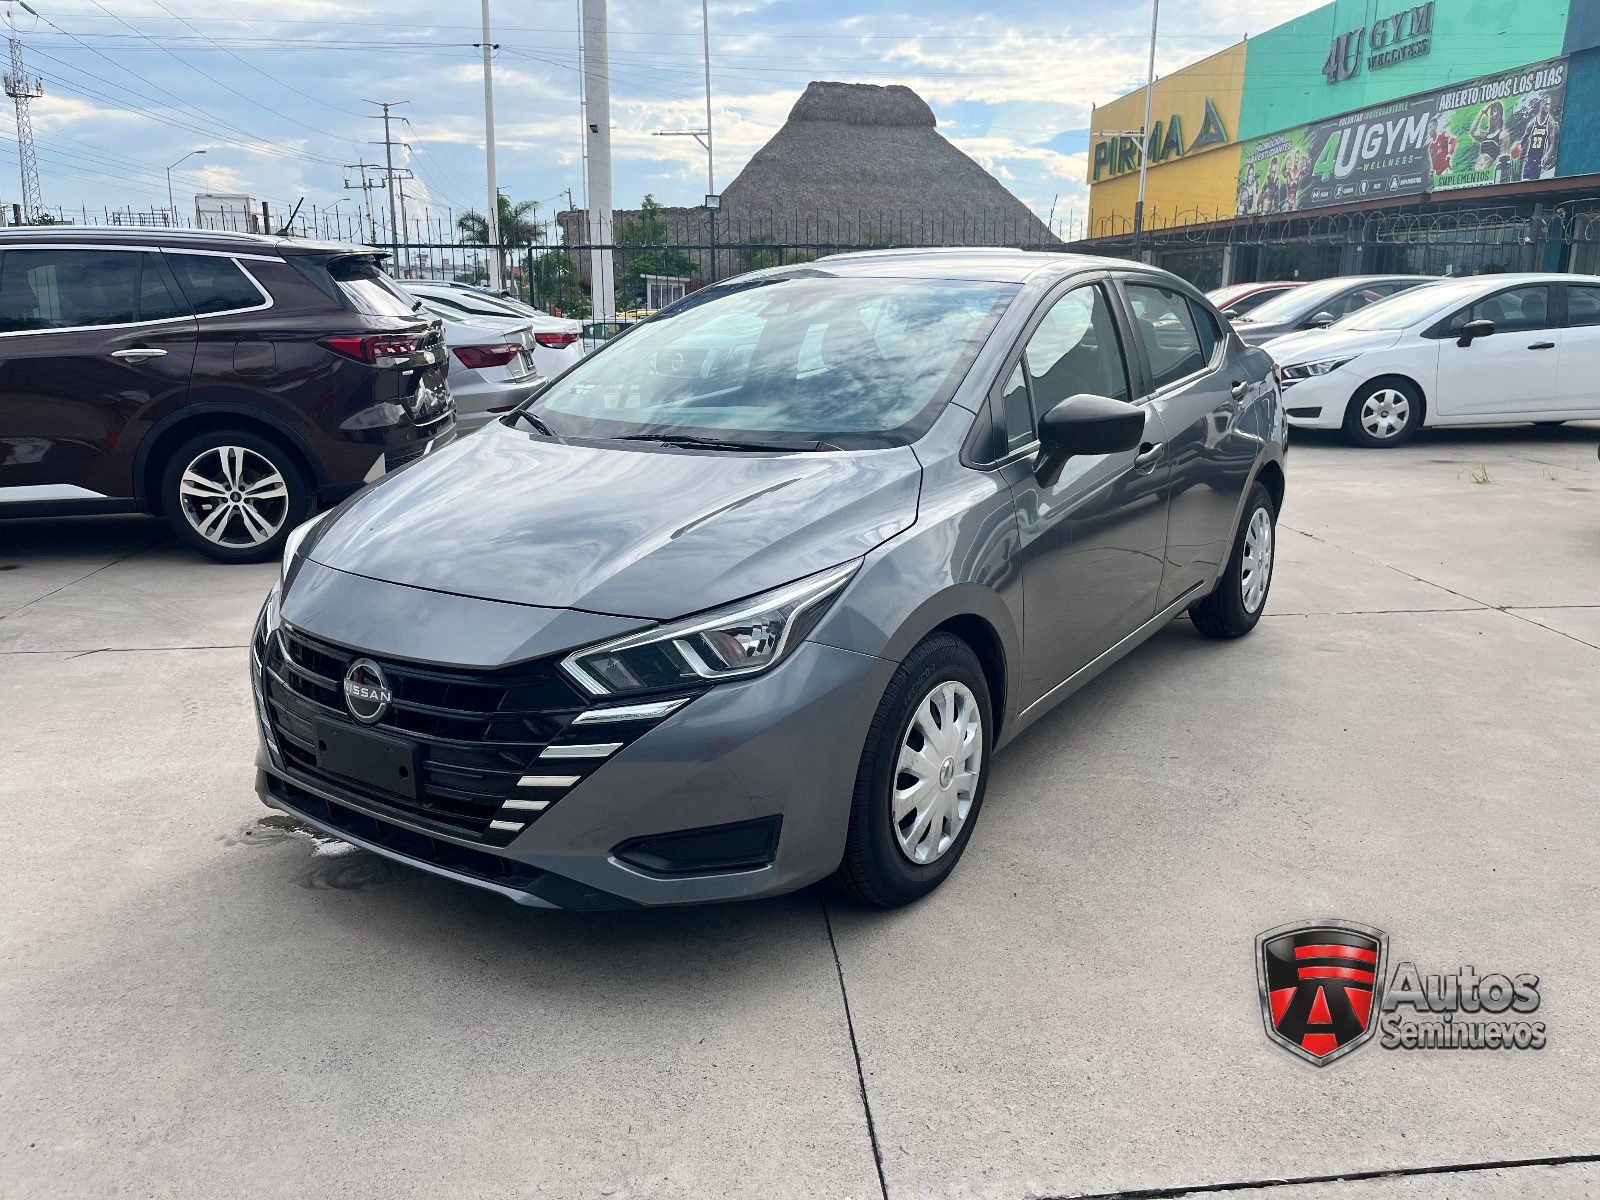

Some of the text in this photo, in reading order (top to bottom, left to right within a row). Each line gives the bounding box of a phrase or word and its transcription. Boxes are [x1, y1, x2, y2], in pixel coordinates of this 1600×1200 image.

[1369, 1, 1435, 51] GYM
[1322, 27, 1365, 85] 4U
[1367, 38, 1431, 72] WELLNESS
[1439, 87, 1480, 112] ABIERTO
[1480, 79, 1512, 102] TODOS
[1513, 72, 1535, 95] LOS
[1093, 114, 1185, 181] PIRMA
[1363, 155, 1415, 172] WELLNESS
[1438, 171, 1490, 187] SUPLEMENTOS
[344, 682, 392, 702] NISSAN
